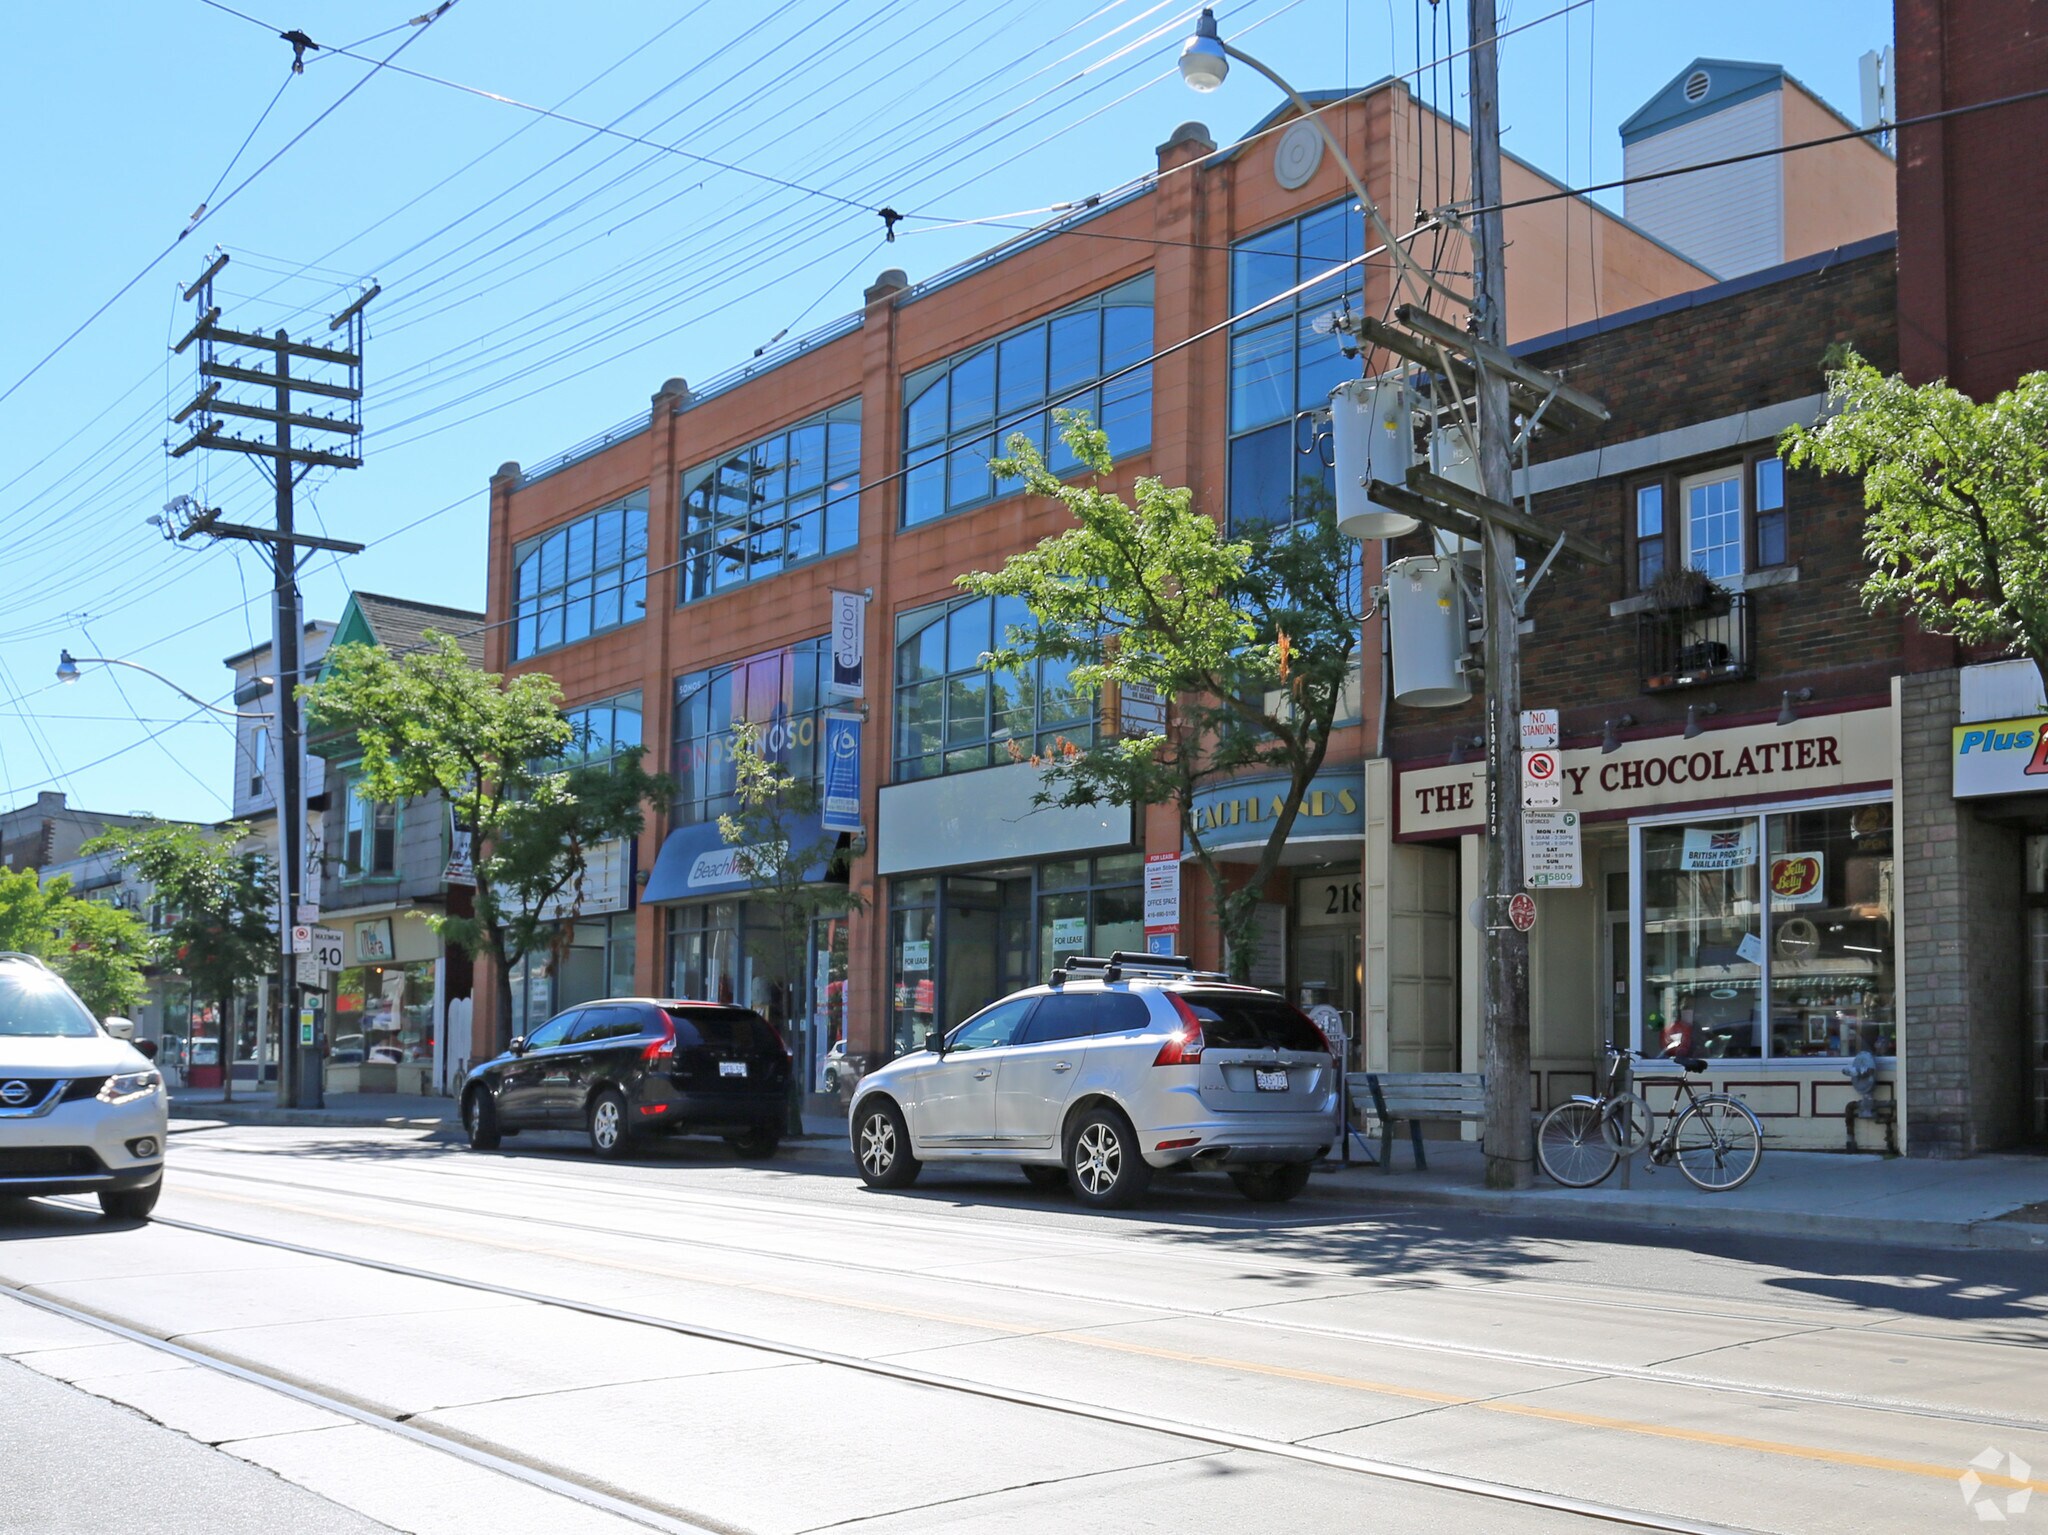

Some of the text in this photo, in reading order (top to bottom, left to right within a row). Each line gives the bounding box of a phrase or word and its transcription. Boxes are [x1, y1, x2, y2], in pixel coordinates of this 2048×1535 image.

[841, 596, 854, 667] avalon
[1532, 713, 1546, 723] NO
[1522, 723, 1557, 736] STANDING
[1960, 729, 2034, 755] Plus
[1416, 782, 1474, 815] THE
[1600, 736, 1841, 792] CHOCOLATIER
[1689, 847, 1752, 859] BRITISH PRODCTS
[1691, 857, 1748, 868] AVAILABLE HERE
[1784, 857, 1806, 877] Jelly
[1548, 873, 1572, 881] 5809
[1775, 875, 1802, 896] Belly
[1163, 897, 1177, 905] SPACE
[1067, 935, 1082, 944] LEASE
[319, 947, 342, 966] 40
[915, 956, 928, 965] LEASE
